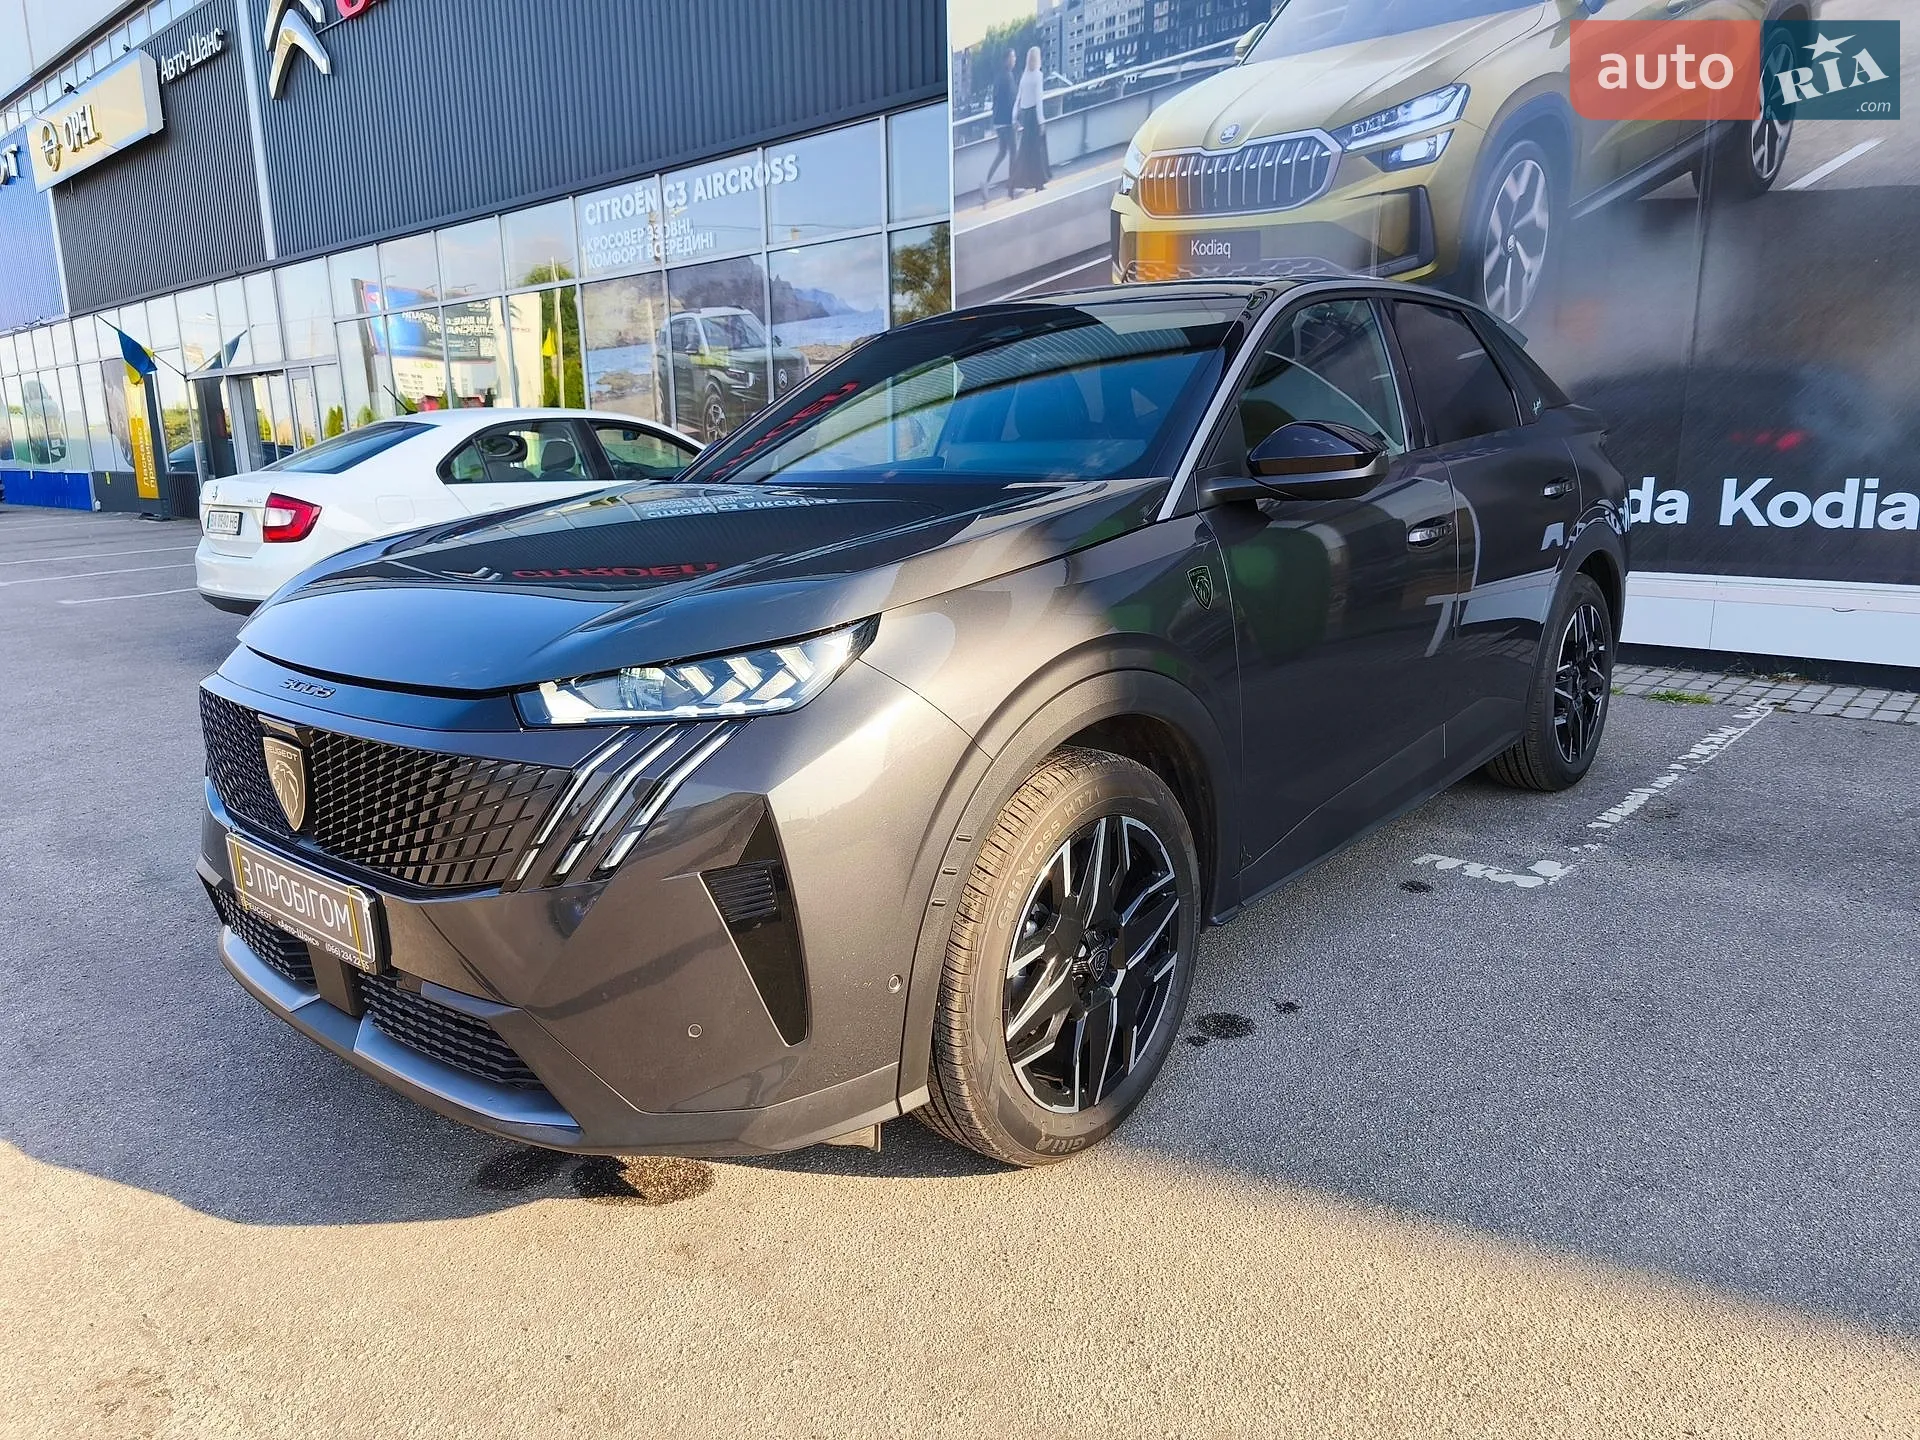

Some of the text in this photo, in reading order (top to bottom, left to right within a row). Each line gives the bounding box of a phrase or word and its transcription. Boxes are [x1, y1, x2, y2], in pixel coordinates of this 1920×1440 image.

[160, 27, 223, 85] Авто-Шанс
[63, 104, 100, 152] OPEL
[584, 153, 799, 226] CITROËN C3 AIRCROSS
[585, 226, 646, 254] КРОСОВЕР
[1191, 239, 1231, 259] Kodiaq
[586, 243, 646, 270] КОМФОРТ
[279, 678, 336, 699] 3008
[265, 744, 299, 761] PEUGEOT
[254, 862, 353, 938] ПРОБІГОМ
